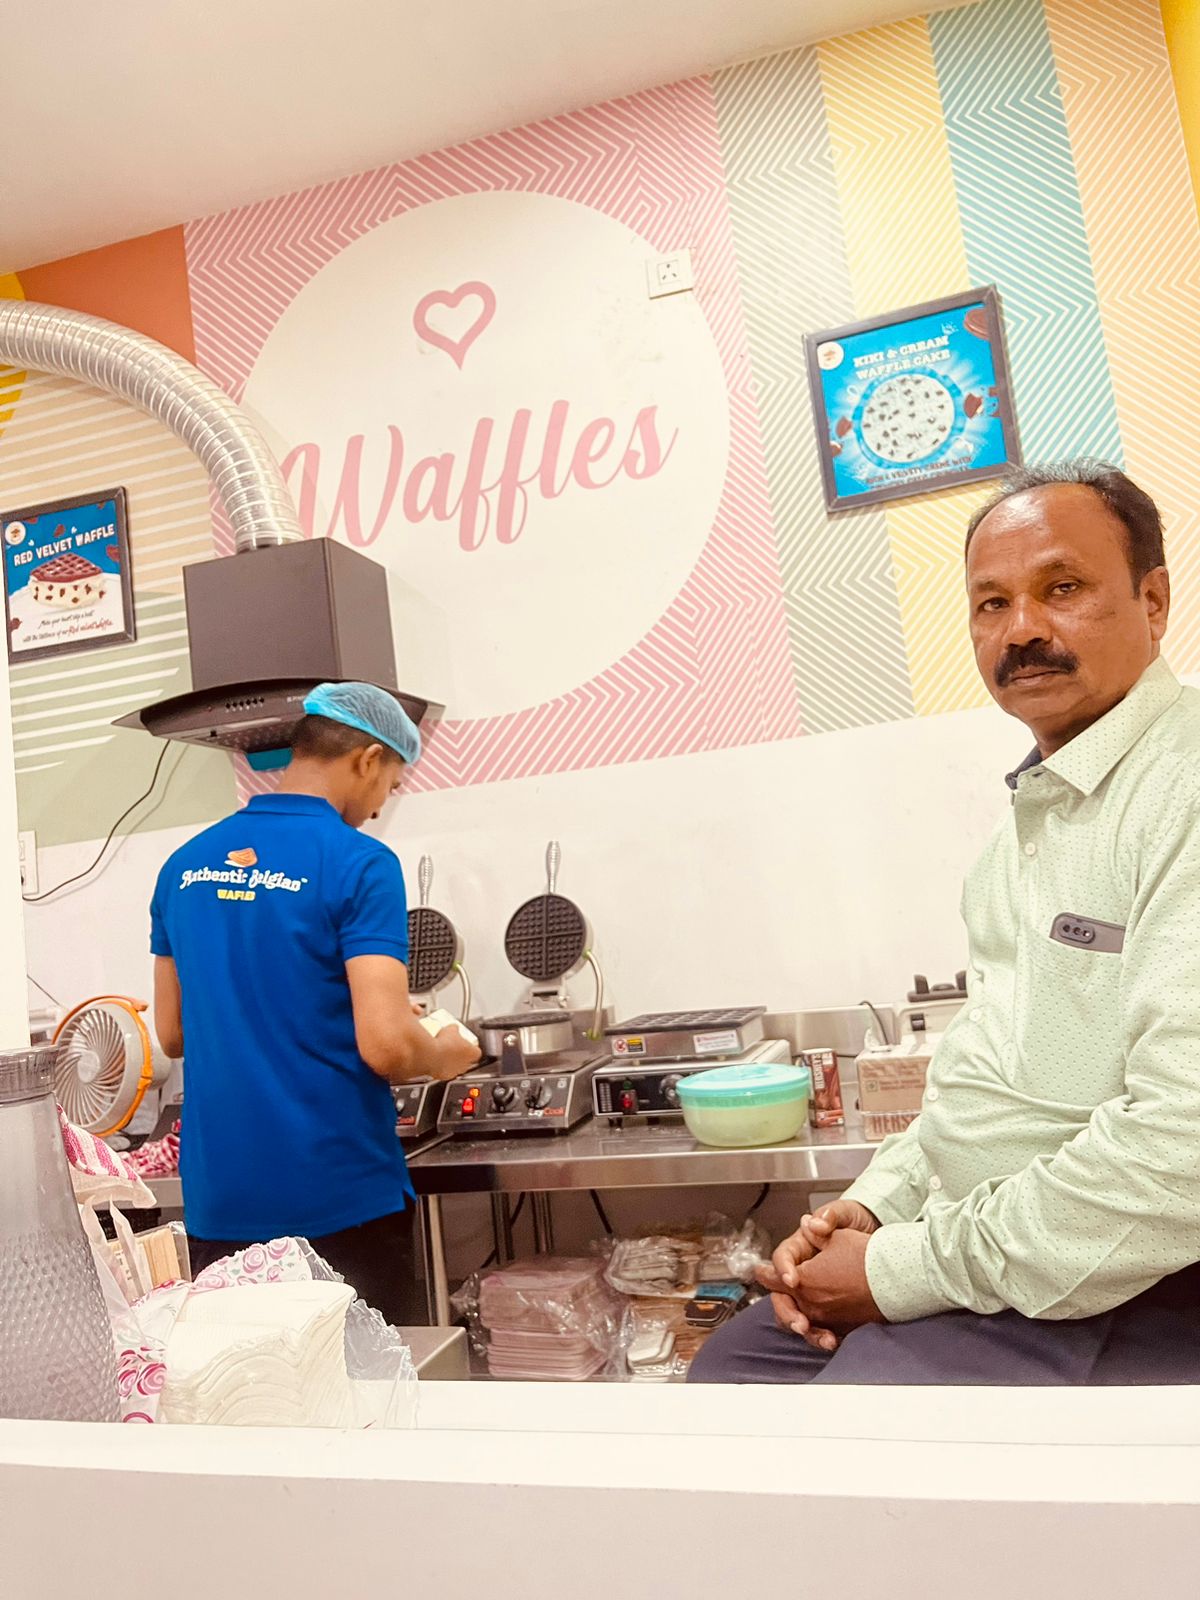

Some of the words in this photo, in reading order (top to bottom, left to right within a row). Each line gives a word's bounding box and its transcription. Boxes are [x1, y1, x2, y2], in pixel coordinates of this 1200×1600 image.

[886, 349, 898, 359] &
[899, 335, 950, 356] CREAM
[856, 359, 912, 380] WAFFLE
[912, 349, 951, 366] CAKE
[280, 399, 679, 552] Waffles
[14, 550, 33, 566] RED
[36, 538, 72, 559] VELVET
[75, 524, 114, 546] WAFFLE
[179, 866, 249, 890] Authentic
[248, 869, 302, 893] Belgian
